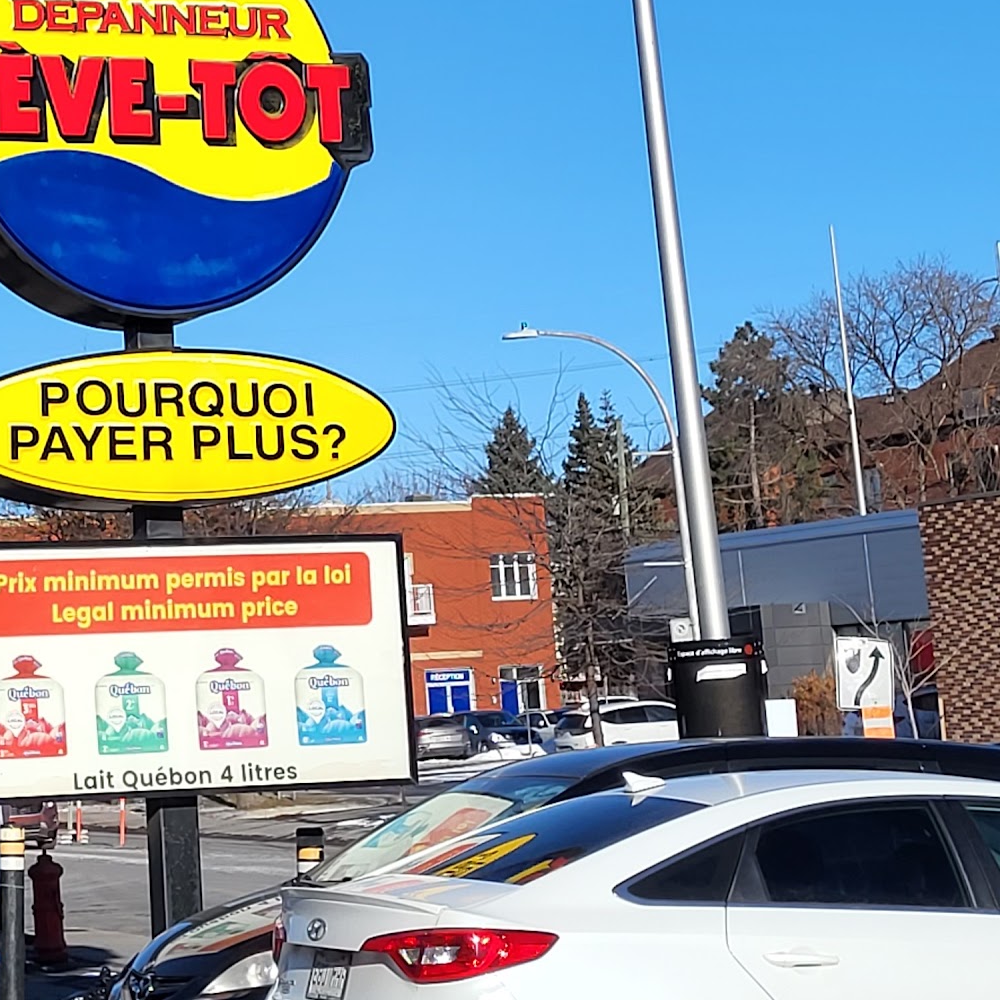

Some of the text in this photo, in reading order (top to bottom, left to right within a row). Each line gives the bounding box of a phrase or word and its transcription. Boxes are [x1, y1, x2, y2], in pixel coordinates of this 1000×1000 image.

[41, 381, 314, 417] POURQUOI
[11, 424, 345, 461] PAYER PLUS?
[43, 570, 159, 592] minimum
[166, 566, 246, 595] permis
[252, 570, 291, 593] par
[296, 565, 317, 585] la
[324, 563, 351, 584] loi
[52, 596, 298, 629] Legal minimum price
[8, 686, 49, 701] Québon
[109, 682, 151, 697] Québon
[210, 679, 250, 693] Québon
[308, 675, 349, 690] Québon
[73, 762, 298, 790] Lait Québon 4 litres
